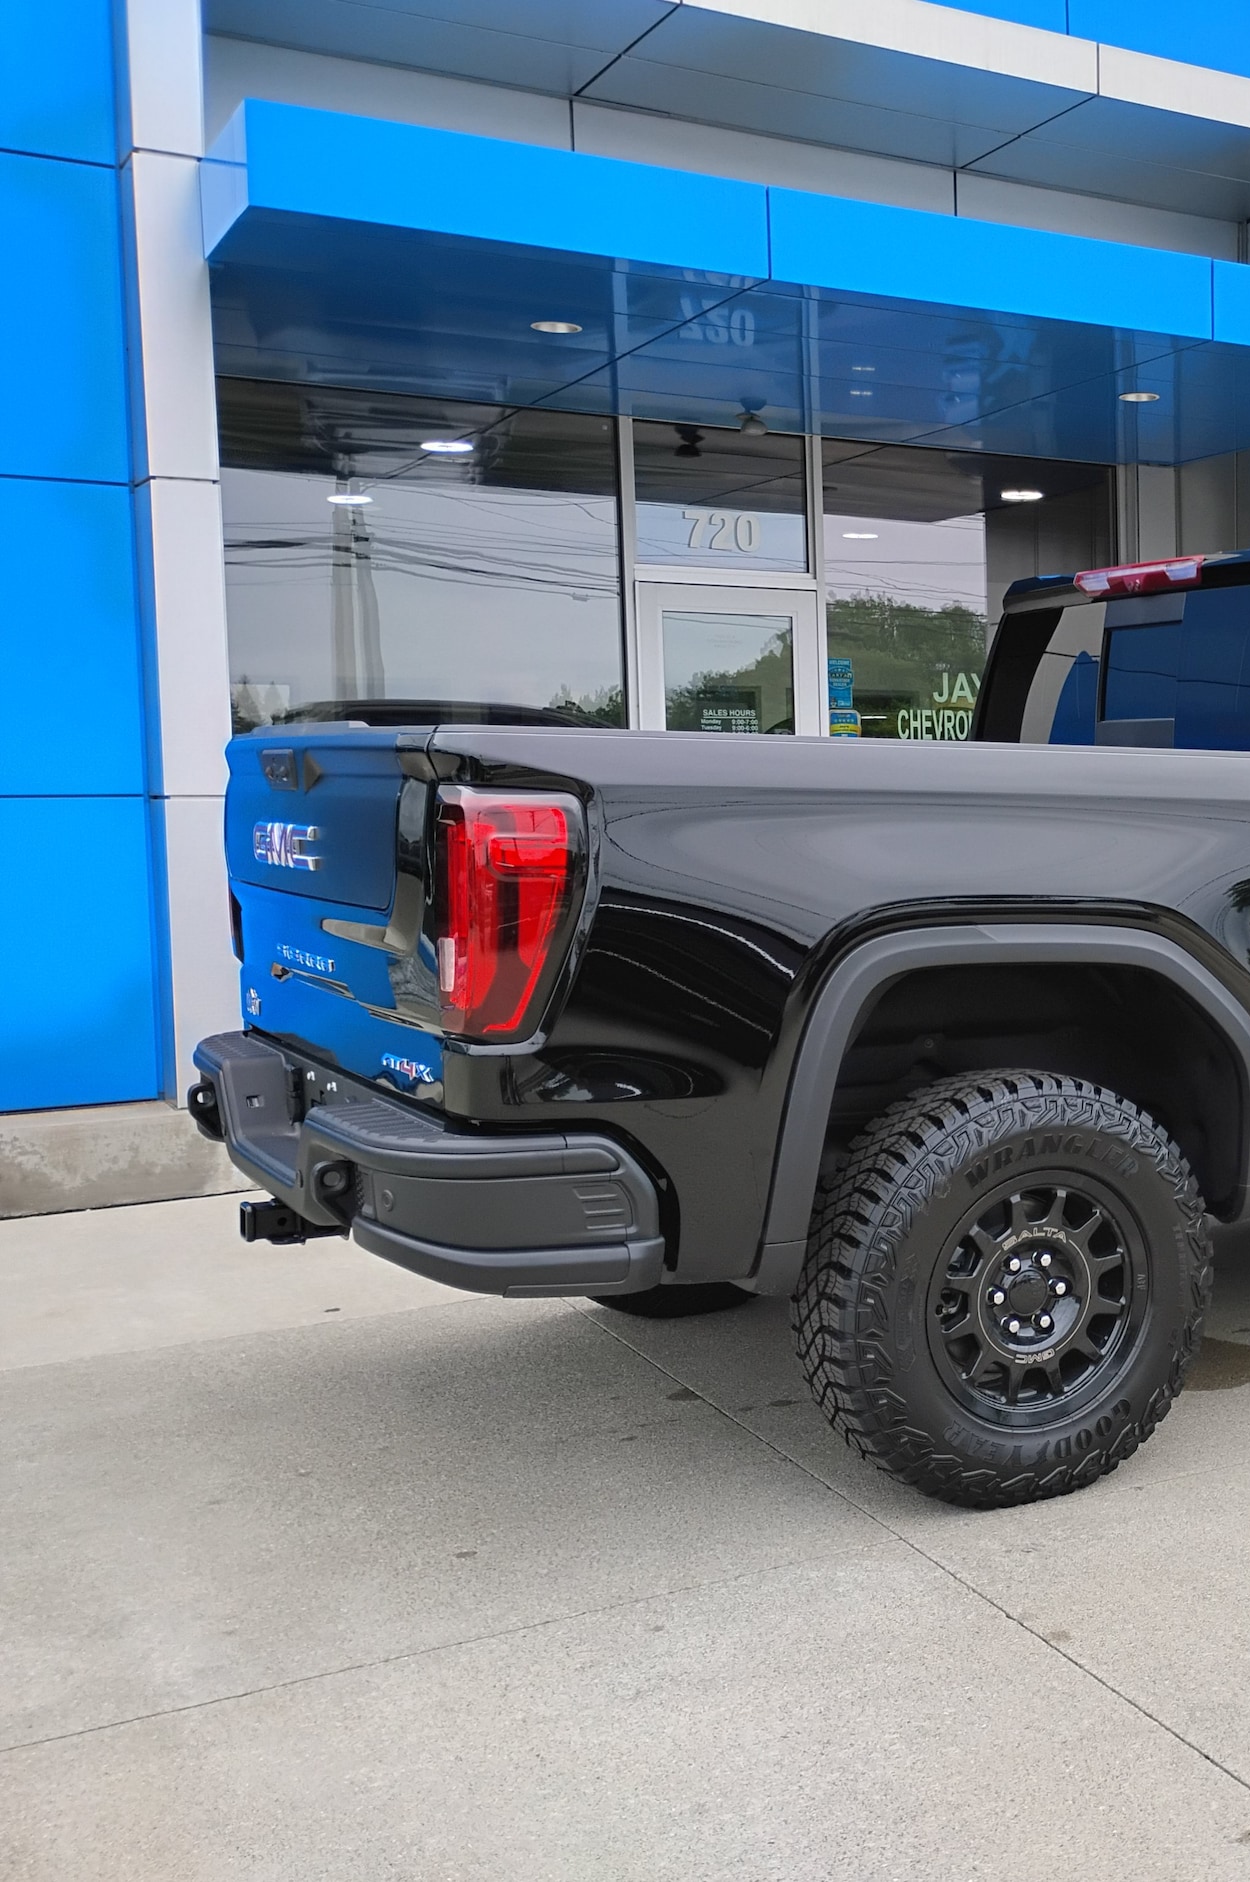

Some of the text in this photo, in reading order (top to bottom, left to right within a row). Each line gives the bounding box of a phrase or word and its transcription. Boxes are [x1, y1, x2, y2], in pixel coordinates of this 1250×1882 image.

[682, 510, 760, 553] 720
[729, 709, 756, 717] HOURS
[253, 822, 321, 871] GMC
[964, 1133, 1139, 1188] WRANGLER
[1002, 1227, 1067, 1250] SALTA
[1014, 1348, 1056, 1364] GMC
